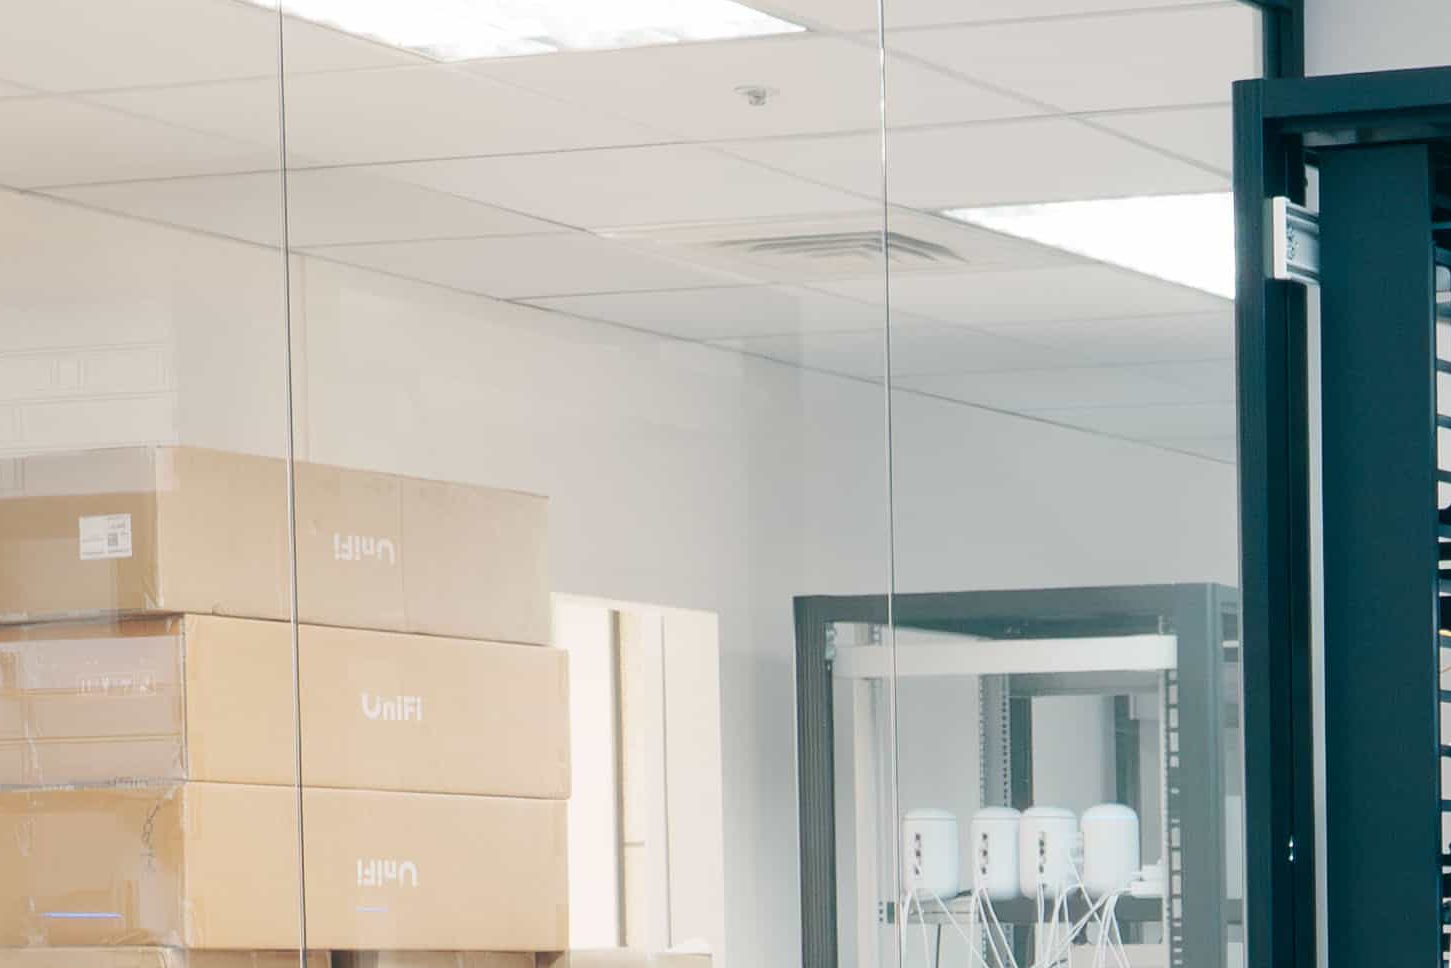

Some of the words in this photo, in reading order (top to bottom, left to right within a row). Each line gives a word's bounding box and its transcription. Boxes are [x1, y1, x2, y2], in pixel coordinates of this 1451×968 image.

[332, 532, 396, 566] UniFi
[361, 692, 424, 723] UniFi
[355, 857, 419, 889] UniFi
